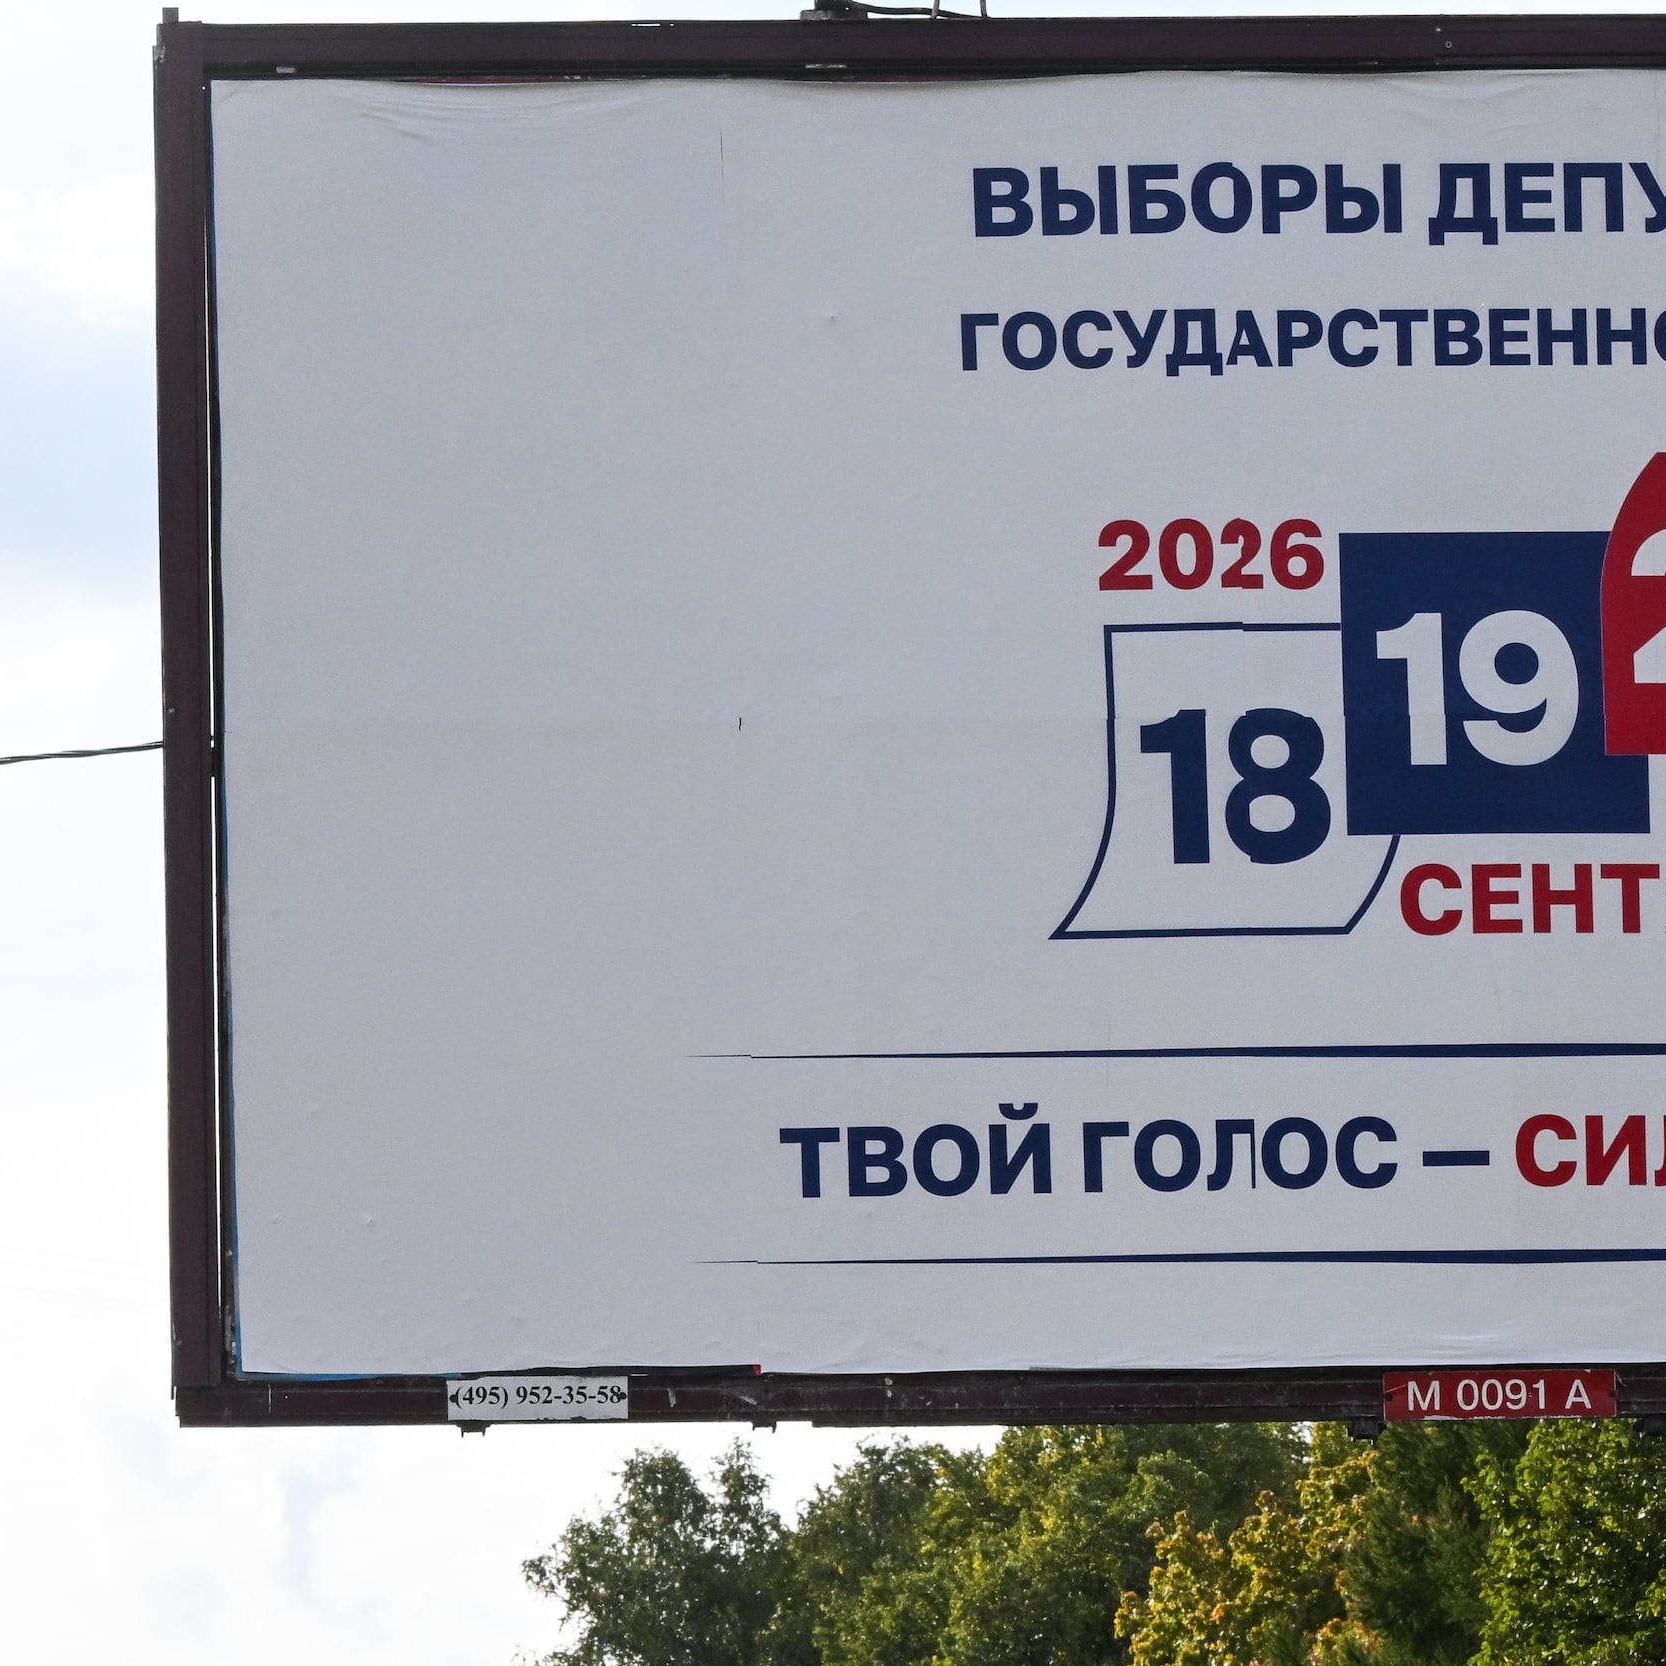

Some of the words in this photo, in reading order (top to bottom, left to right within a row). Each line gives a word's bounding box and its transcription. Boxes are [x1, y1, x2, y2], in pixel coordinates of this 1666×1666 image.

[973, 162, 1402, 237] ВЫБОРЫ
[1098, 518, 1324, 591] 2026
[1376, 610, 1579, 765] 19
[1140, 708, 1331, 864] 18
[780, 1103, 1052, 1198] ТВОЙ
[1083, 1116, 1397, 1196] ГОЛОС
[455, 1386, 509, 1409] (495)
[516, 1386, 622, 1405] 952-35-58
[1408, 1380, 1440, 1411] M
[1457, 1379, 1545, 1411] 0091
[1565, 1379, 1592, 1410] A
